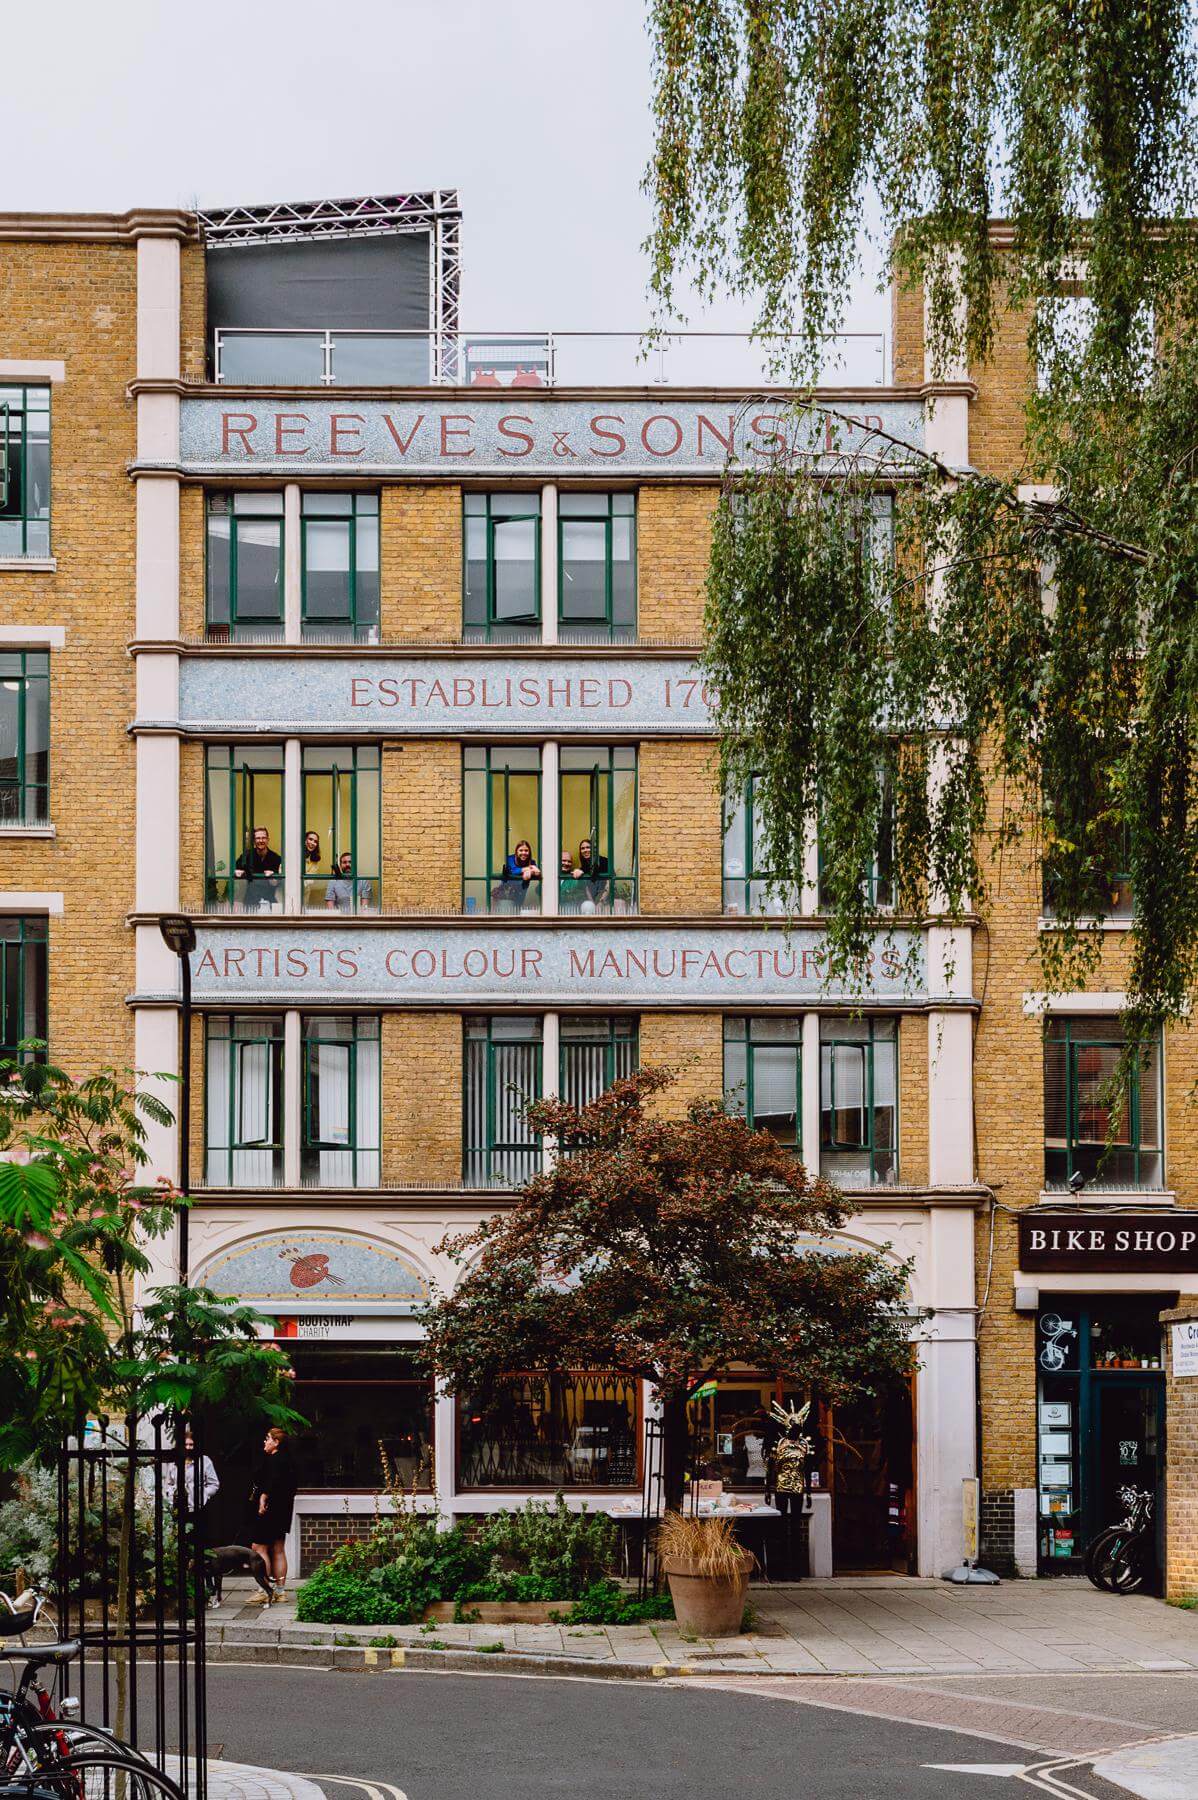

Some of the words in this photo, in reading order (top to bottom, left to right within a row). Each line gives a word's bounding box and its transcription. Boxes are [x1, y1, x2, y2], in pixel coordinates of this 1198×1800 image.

[221, 413, 535, 457] REEVES
[552, 432, 577, 457] &
[588, 415, 790, 457] SONS
[350, 678, 633, 708] ESTABLISHED
[664, 679, 722, 708] 176
[195, 948, 363, 978] ARTISTS'
[385, 949, 543, 978] COLOUR
[1029, 1230, 1106, 1251] BIKE
[1114, 1230, 1196, 1252] SHOP
[298, 1315, 353, 1327] BOOTSTRAP
[298, 1326, 330, 1337] CHARITY
[1188, 1325, 1198, 1340] Cr
